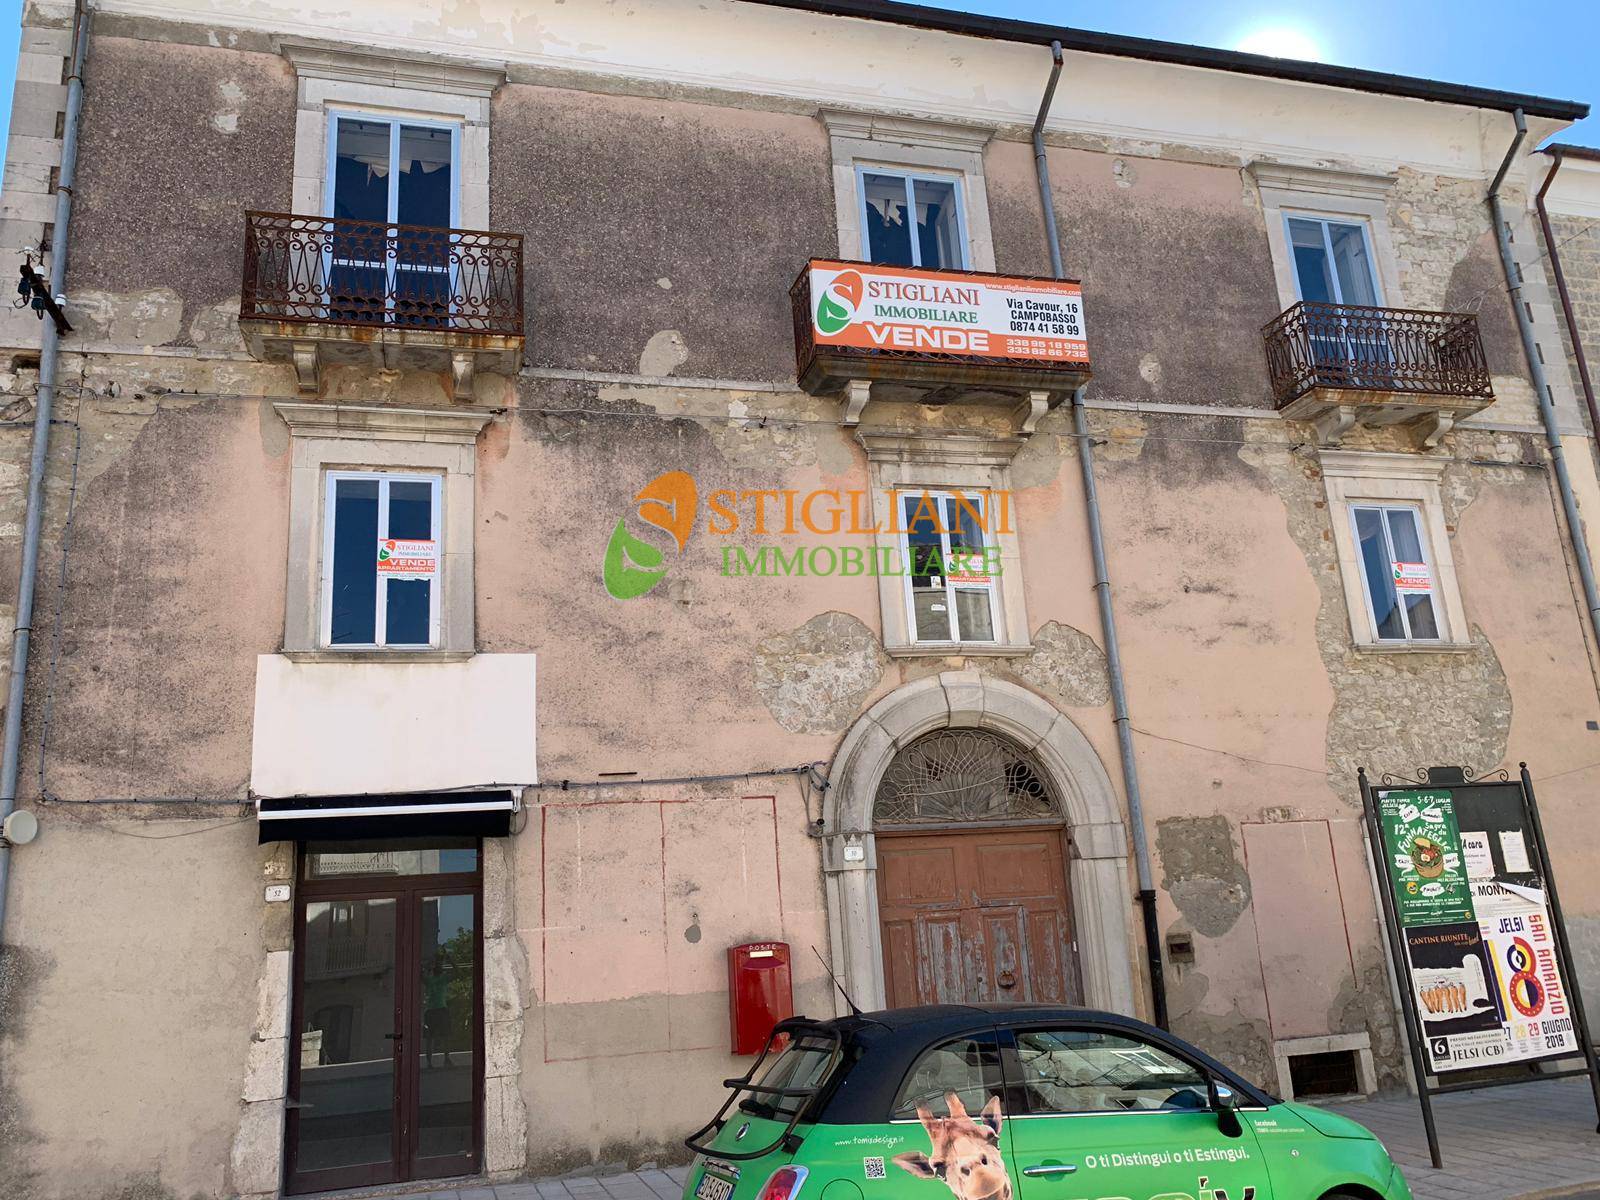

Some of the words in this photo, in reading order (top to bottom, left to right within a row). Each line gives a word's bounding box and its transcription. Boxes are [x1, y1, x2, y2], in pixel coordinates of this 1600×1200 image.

[868, 281, 981, 306] STIGLIANI
[874, 304, 979, 324] IMMOBILIARE
[1006, 298, 1023, 309] Via
[1026, 300, 1063, 313] Cavour,
[1066, 303, 1078, 314] 16
[1011, 310, 1076, 324] CAMPOBASSO
[1010, 320, 1036, 333] 0874
[1038, 322, 1049, 334] 41
[1052, 324, 1064, 335] 58
[1067, 325, 1079, 336] 99
[865, 324, 990, 352] VENDE
[391, 558, 435, 566] VENDE
[1425, 822, 1447, 832] Sagra
[1499, 916, 1525, 934] JELSI
[1528, 914, 1547, 942] SAN
[1409, 935, 1440, 945] CANTINE
[1440, 933, 1468, 942] RIUNITE
[1537, 948, 1565, 1015] AMANZIO
[1528, 1022, 1540, 1037] 29
[1541, 1017, 1572, 1035] GIUGNO
[1434, 1039, 1446, 1055] 6
[1545, 1034, 1565, 1049] 2019
[1453, 1047, 1480, 1062] JELSI
[1482, 1045, 1504, 1057] (CB)
[1085, 1155, 1097, 1168] O
[1099, 1153, 1110, 1167] ti
[1111, 1150, 1171, 1167] Distingui
[1173, 1152, 1182, 1163] o
[1183, 1149, 1194, 1162] ti
[1194, 1145, 1250, 1162] Estingui.
